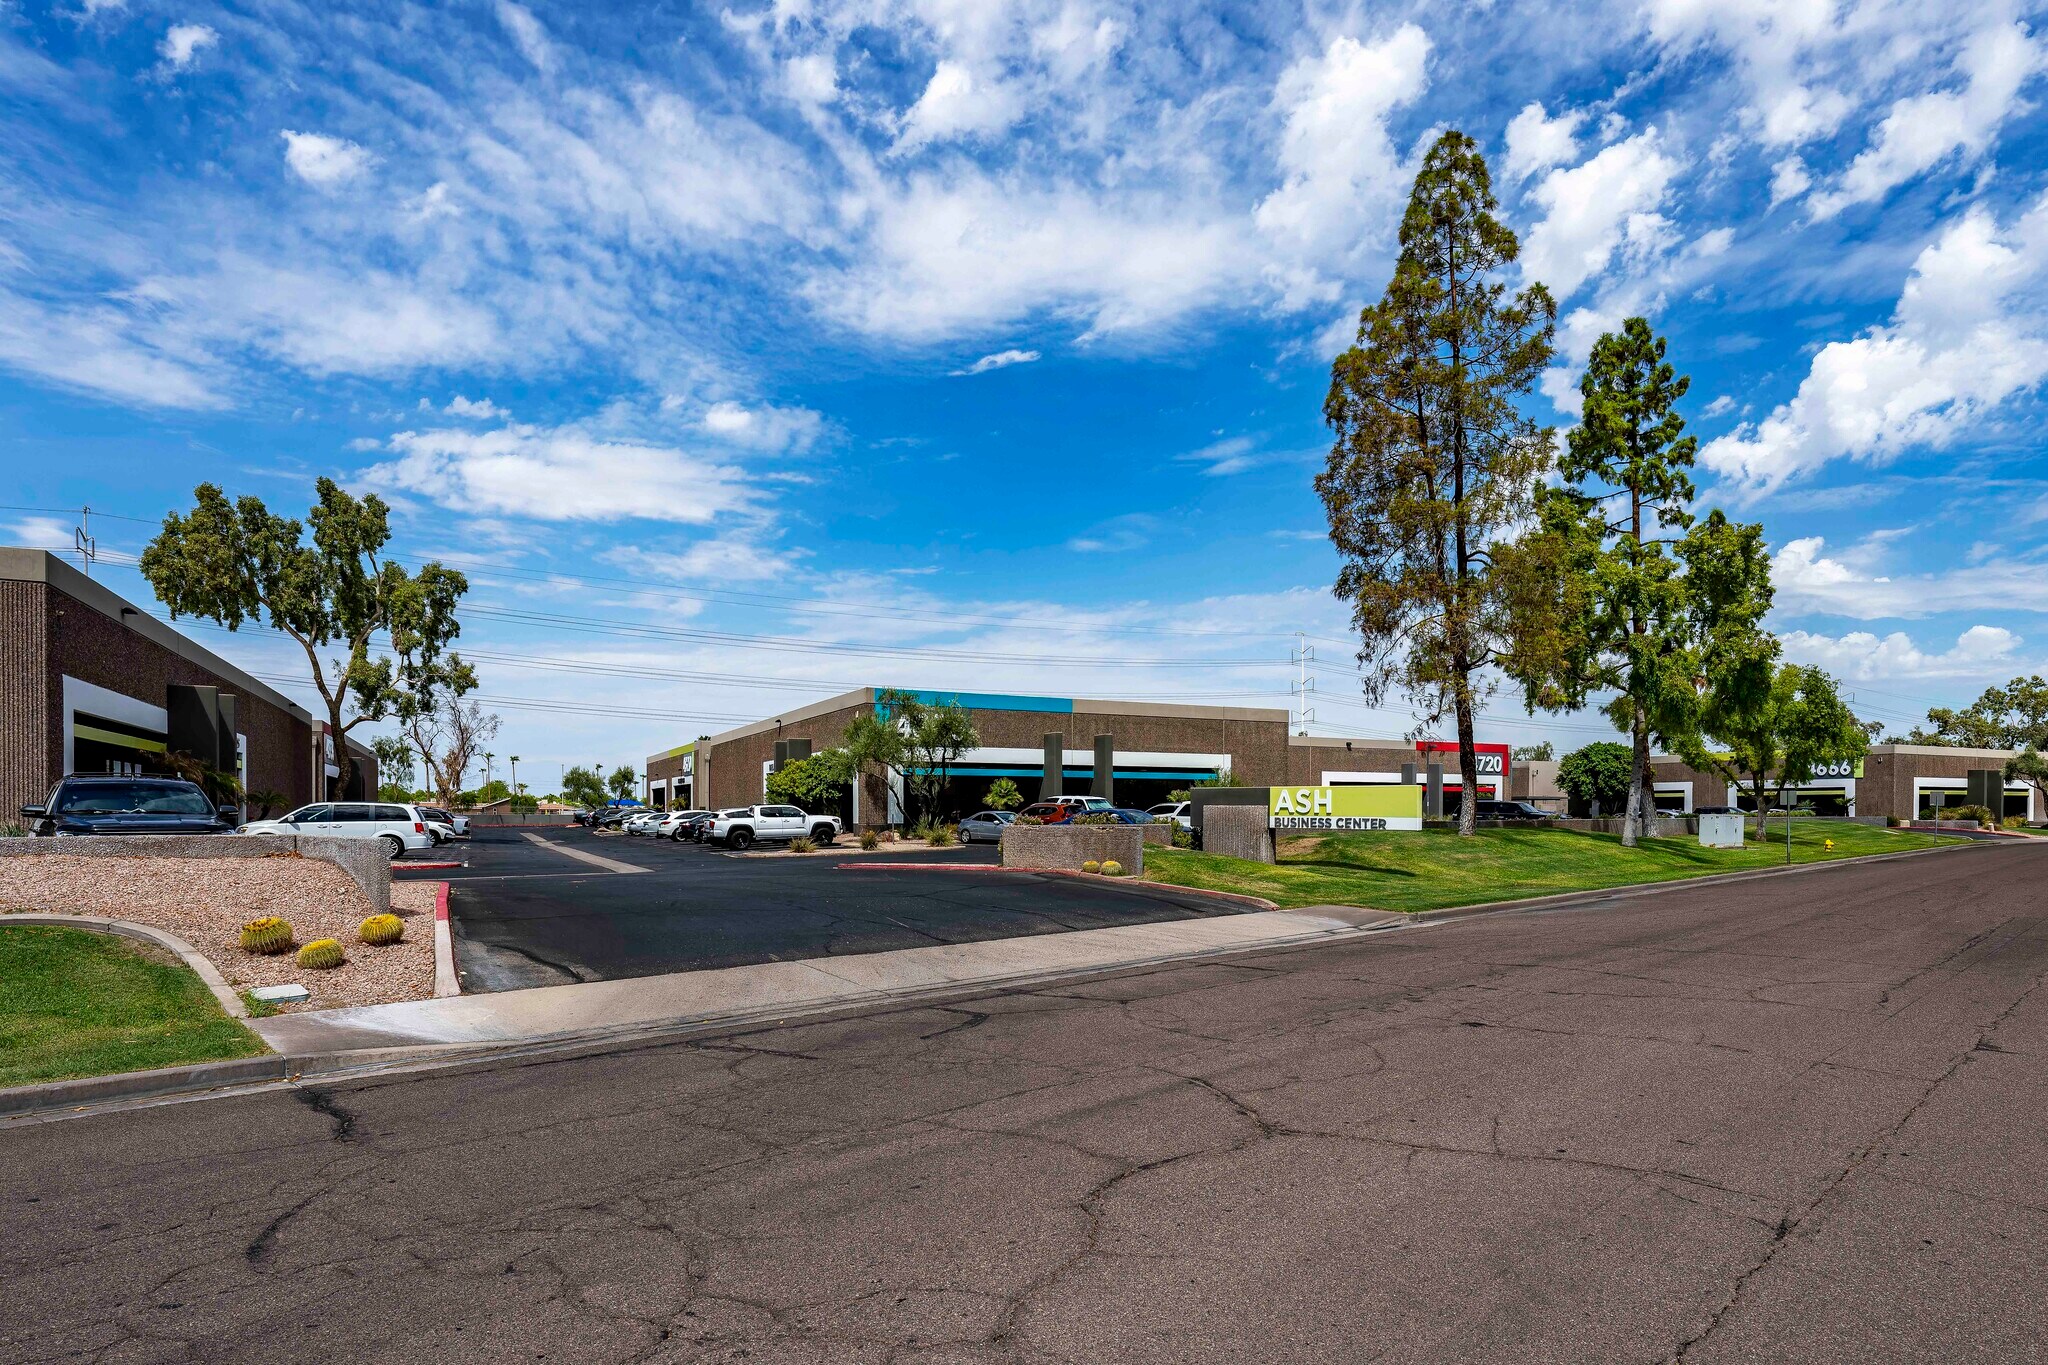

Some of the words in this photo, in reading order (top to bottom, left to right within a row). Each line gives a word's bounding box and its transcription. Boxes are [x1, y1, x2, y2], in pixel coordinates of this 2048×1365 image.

[1475, 755, 1503, 773] 720
[1274, 789, 1333, 815] ASH
[1274, 817, 1332, 829] BUSINESS
[1335, 818, 1387, 831] CENTER
